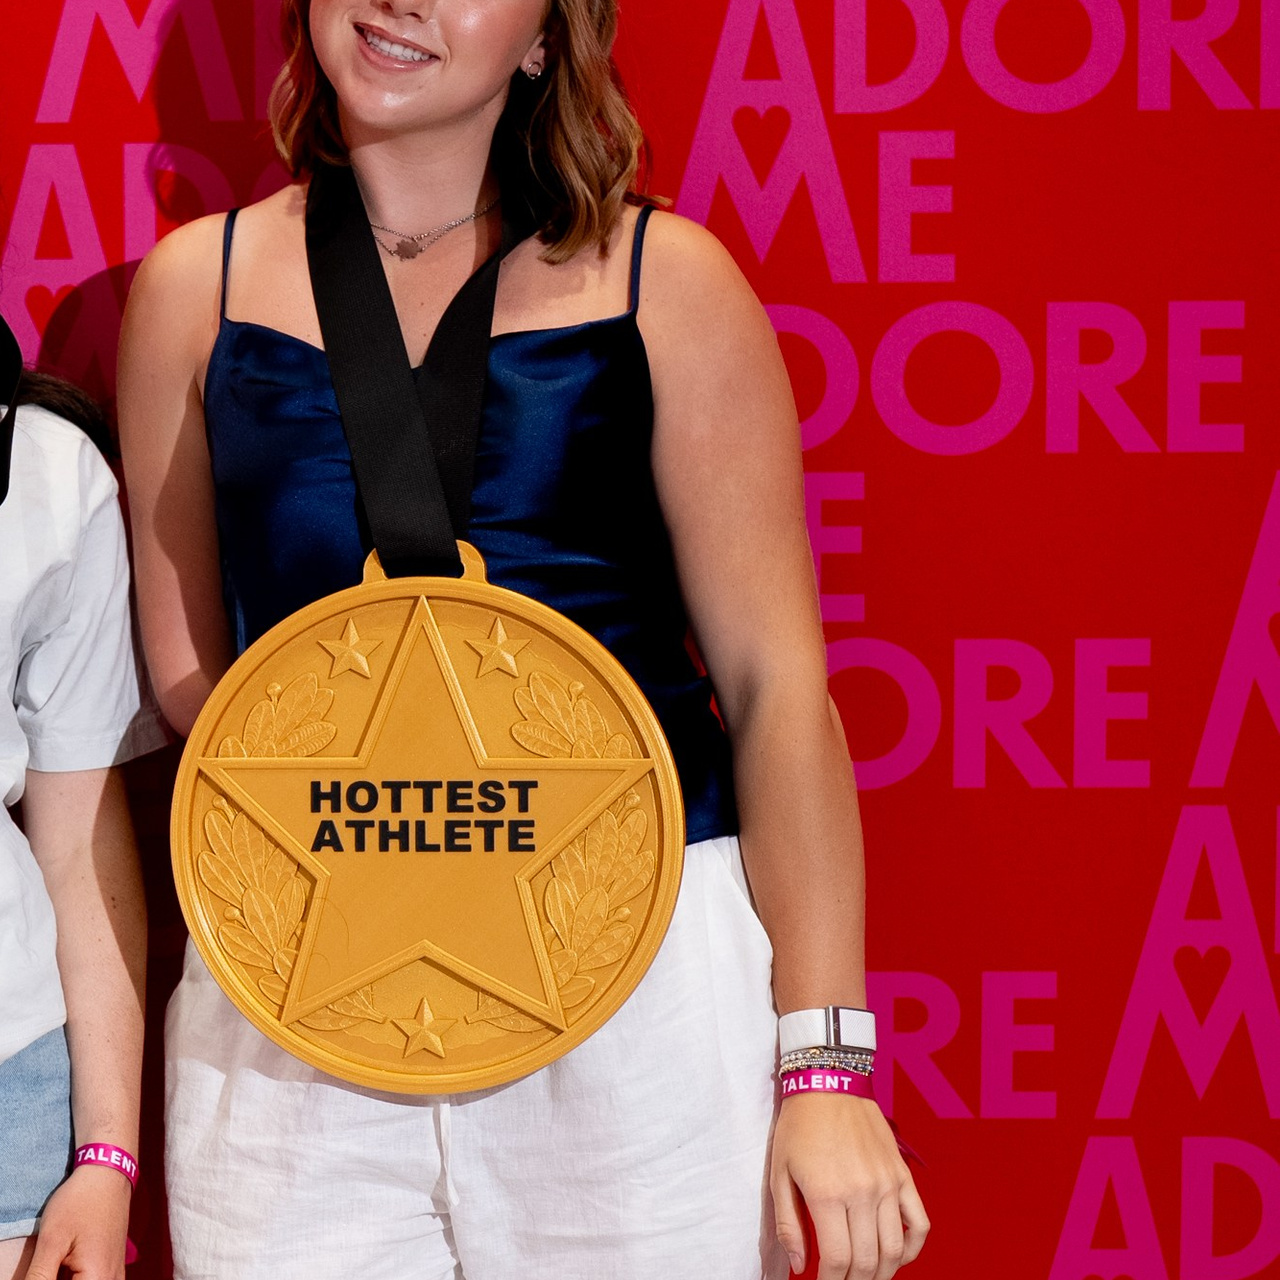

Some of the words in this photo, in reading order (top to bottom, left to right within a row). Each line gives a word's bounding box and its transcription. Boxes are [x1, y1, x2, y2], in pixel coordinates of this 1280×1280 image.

[675, 106, 956, 283] ME
[764, 300, 1245, 455] DORE
[826, 638, 1151, 790] ORE
[310, 780, 538, 813] HOTTEST
[310, 820, 536, 852] ATHLETE
[782, 1074, 852, 1094] TALENT
[77, 1147, 137, 1178] TALENT
